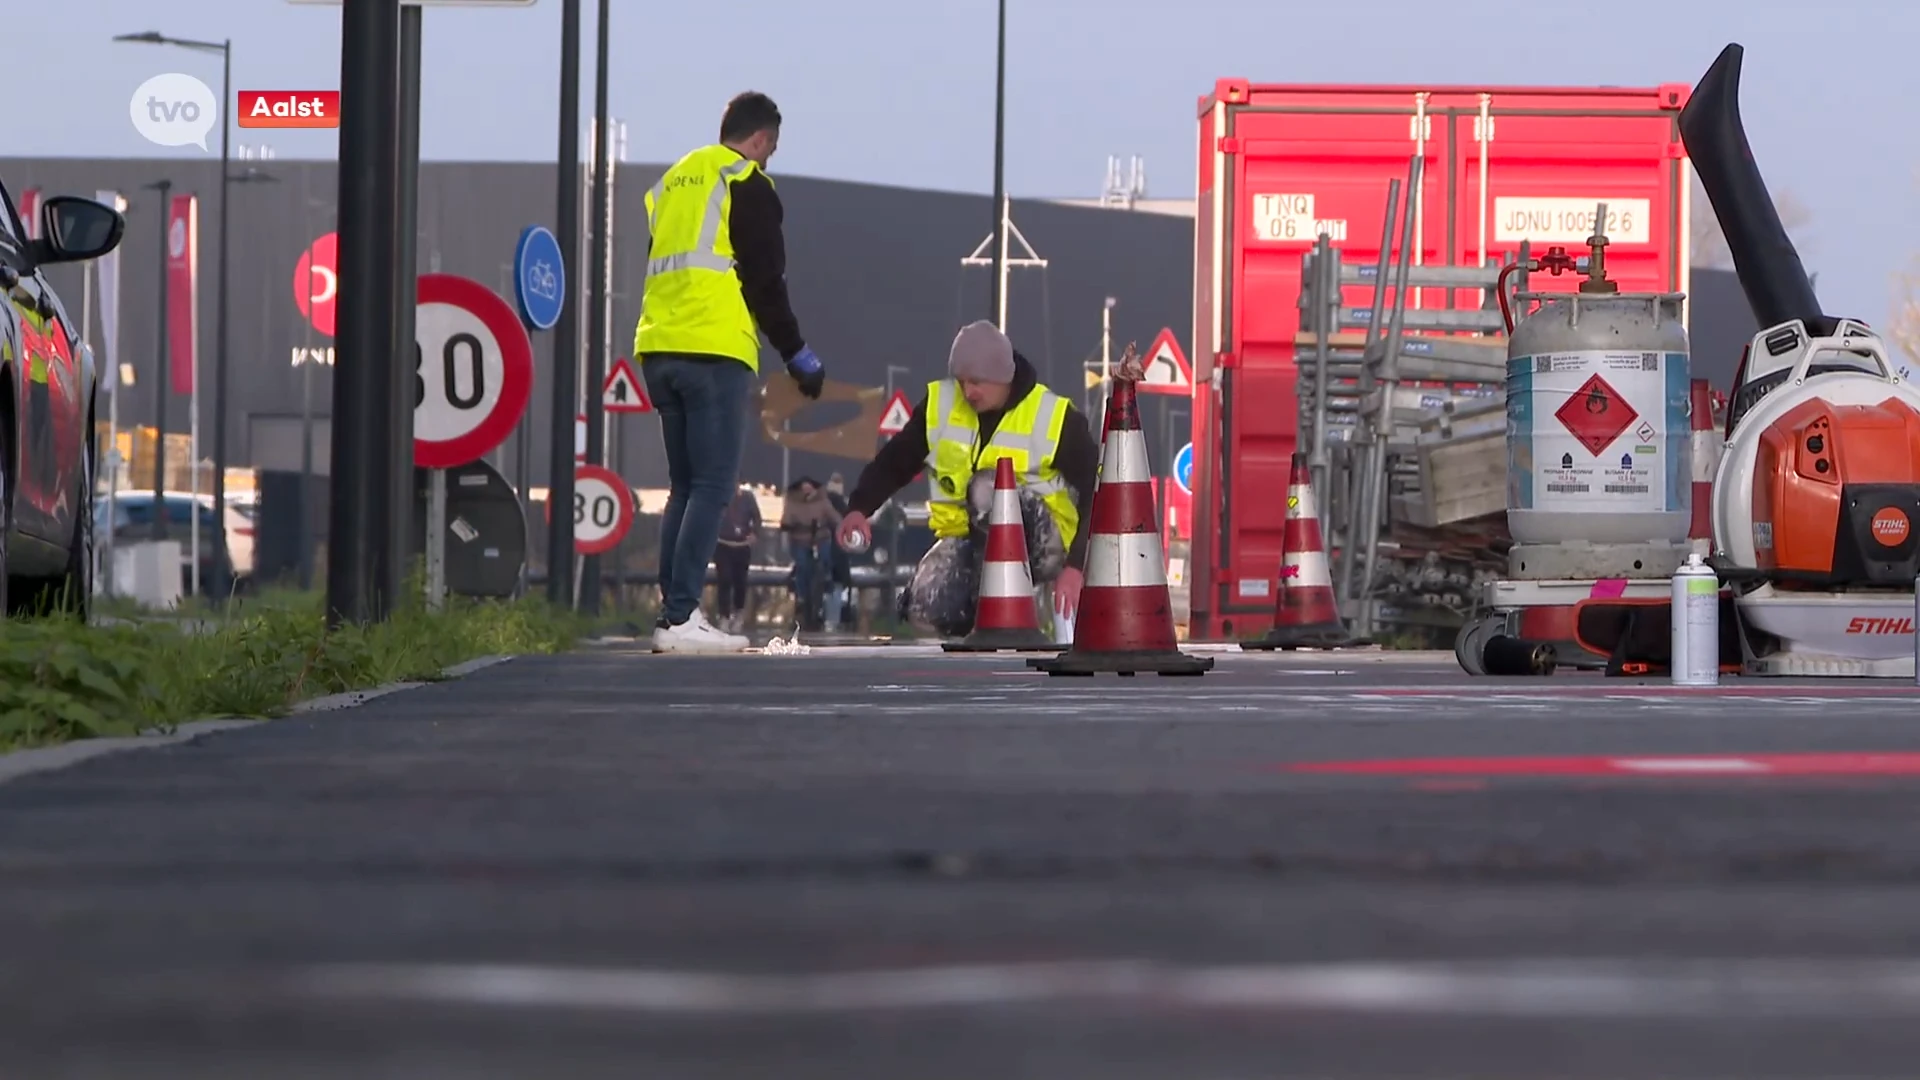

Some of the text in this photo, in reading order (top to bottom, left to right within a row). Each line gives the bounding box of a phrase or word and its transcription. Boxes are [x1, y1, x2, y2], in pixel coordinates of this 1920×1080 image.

[1262, 195, 1308, 216] TNQ
[1270, 218, 1296, 238] 06
[1505, 211, 1552, 232] JDNU
[1558, 211, 1617, 232] 10052
[1873, 519, 1906, 529] STIHL
[1846, 617, 1916, 634] STIHL
